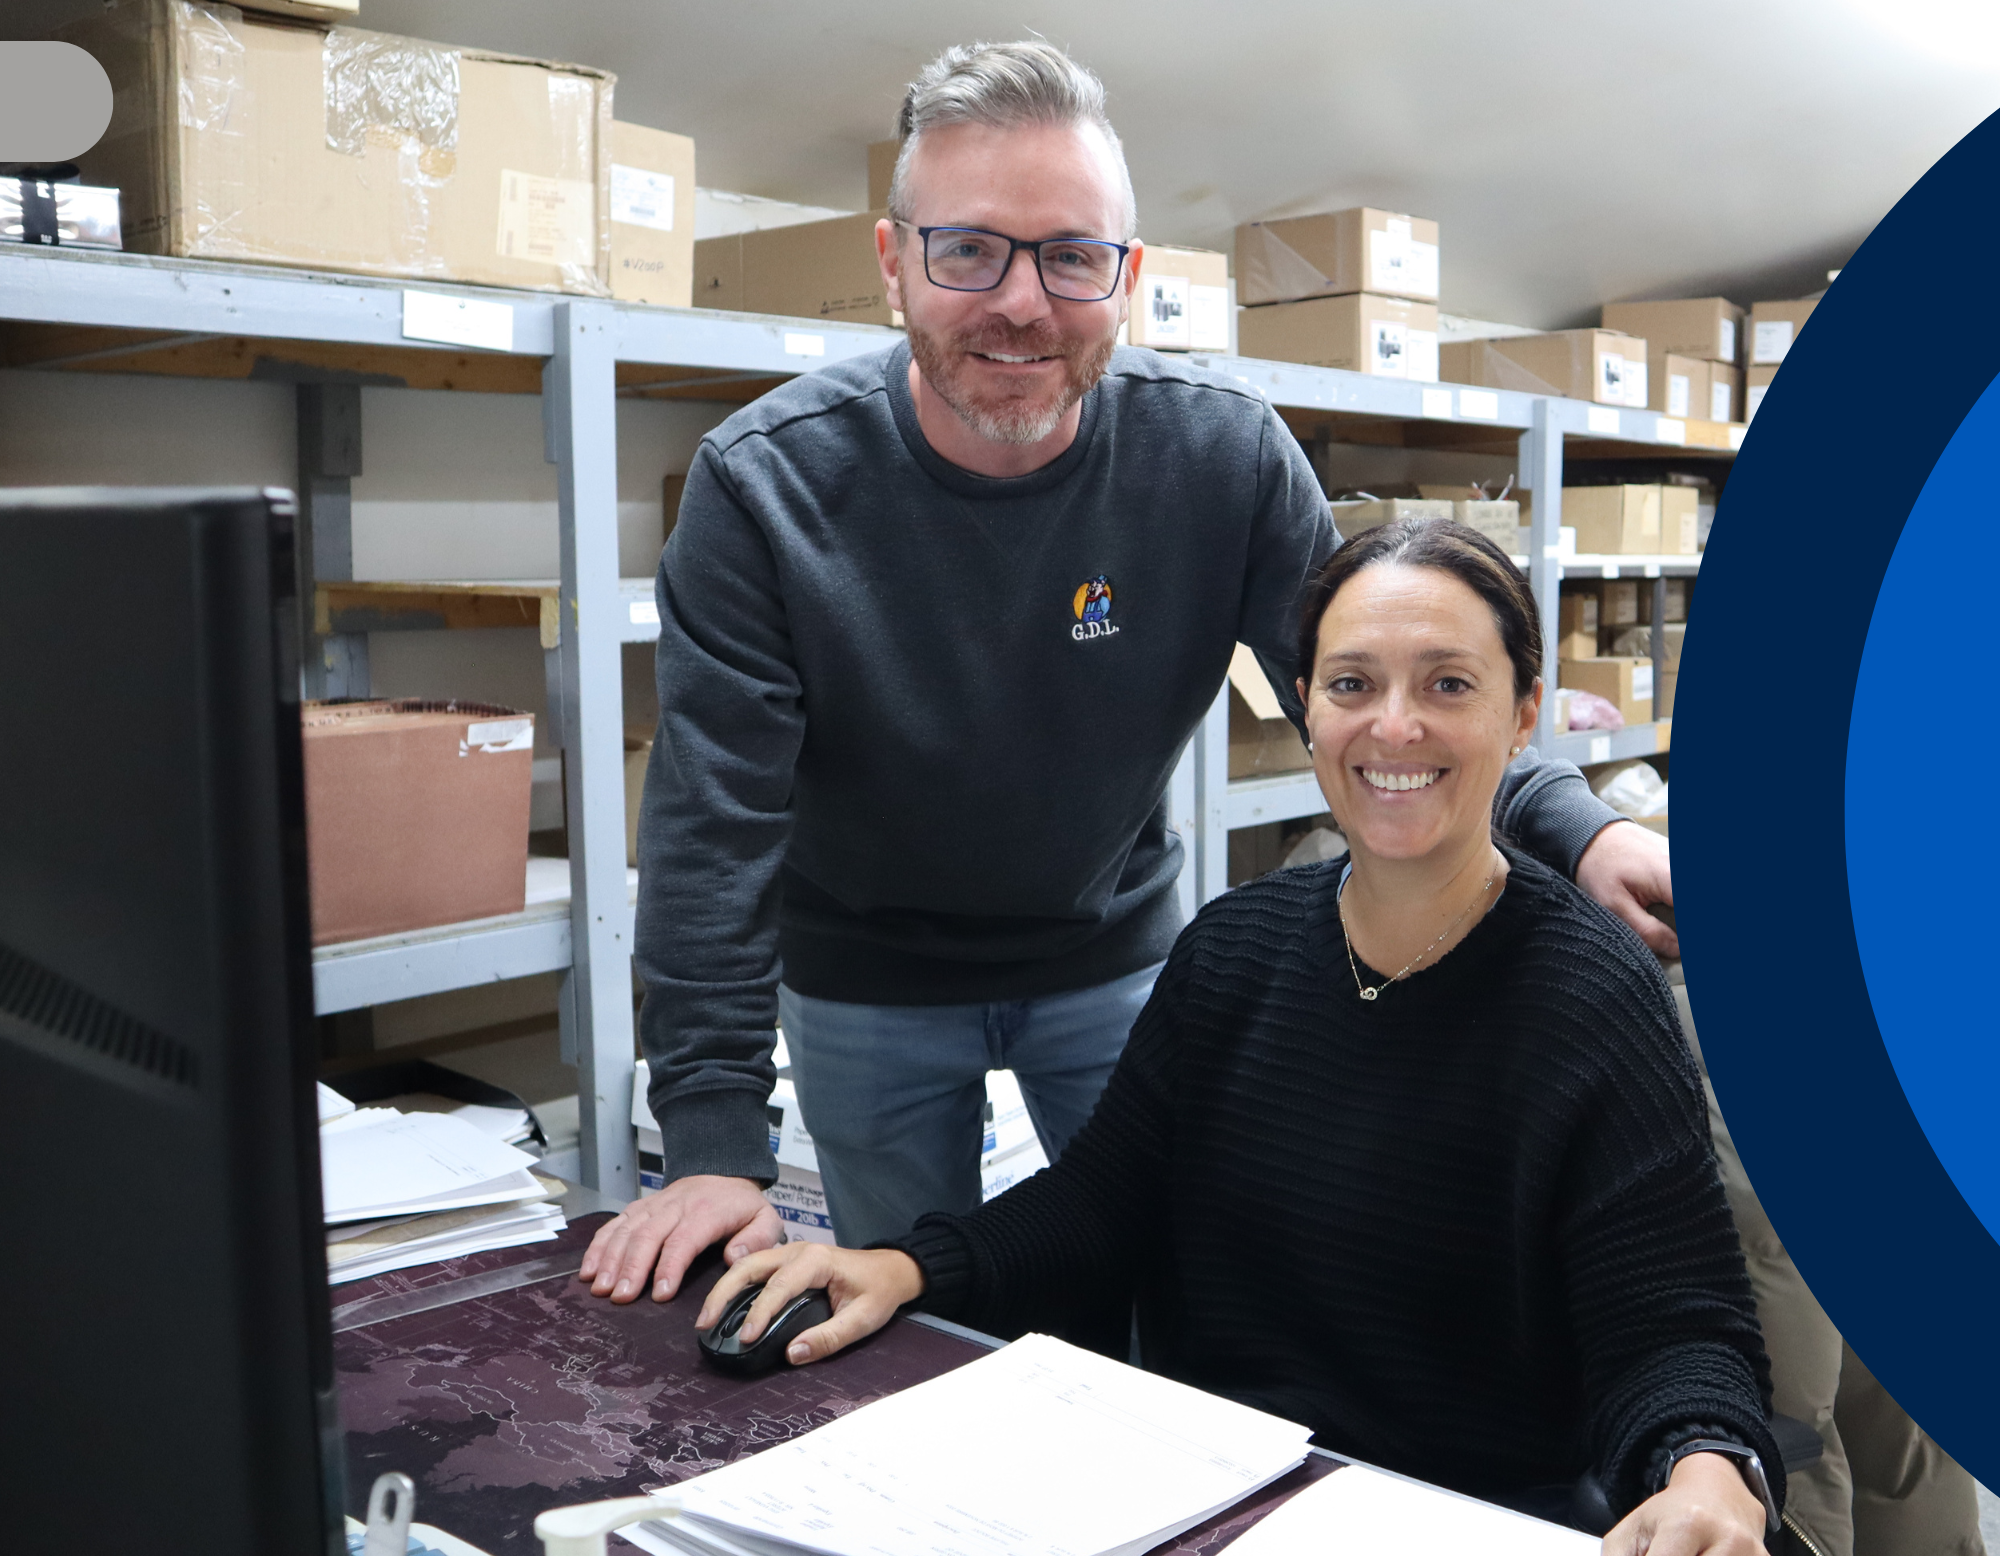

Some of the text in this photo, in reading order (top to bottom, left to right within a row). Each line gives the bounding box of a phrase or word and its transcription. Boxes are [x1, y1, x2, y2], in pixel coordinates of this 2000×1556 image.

[1071, 618, 1120, 641] G.D.L.
[796, 1193, 825, 1209] Papier
[796, 1210, 820, 1226] 20lb
[506, 1376, 539, 1394] CHINA
